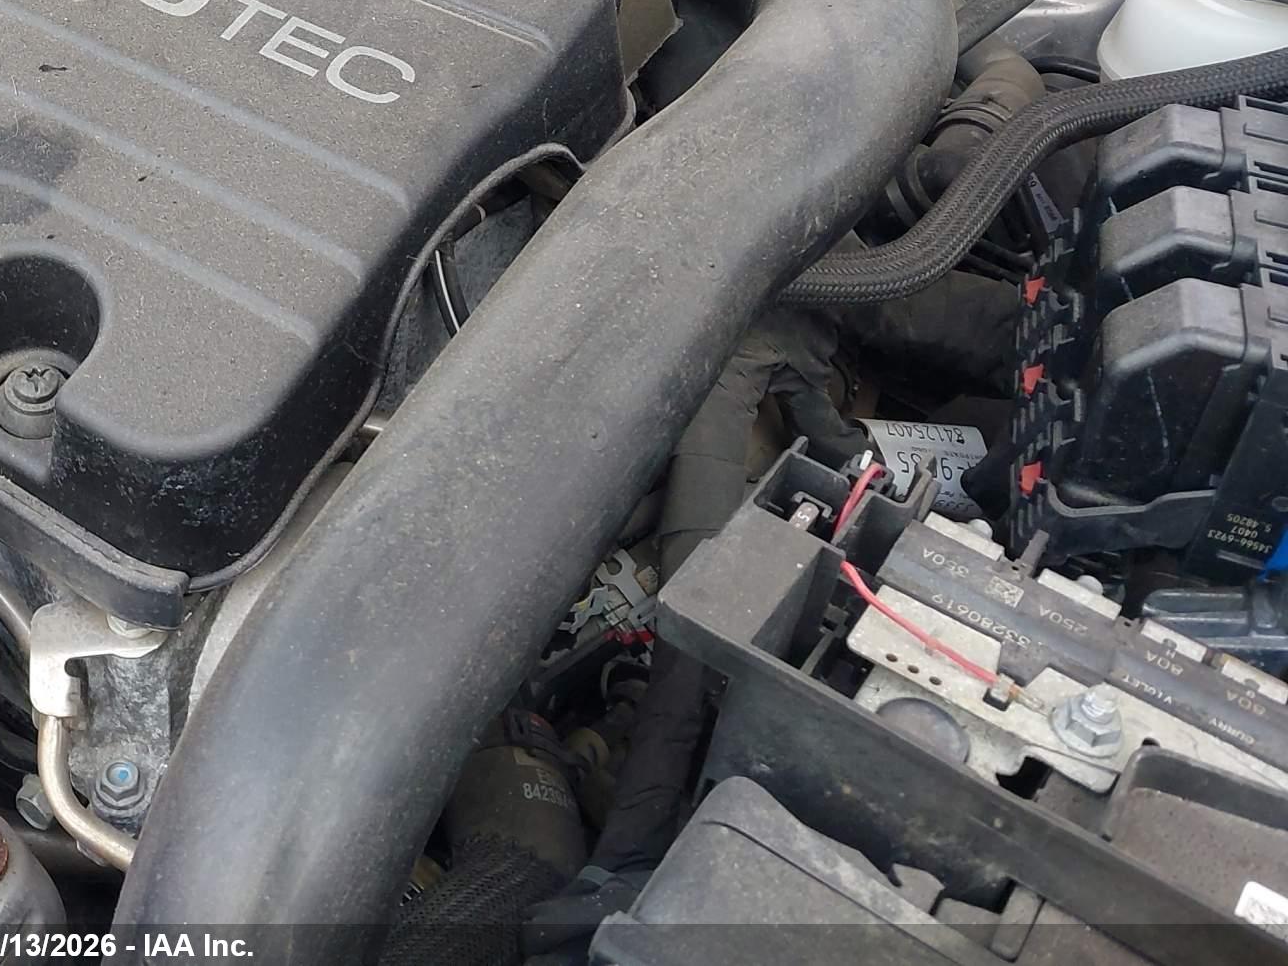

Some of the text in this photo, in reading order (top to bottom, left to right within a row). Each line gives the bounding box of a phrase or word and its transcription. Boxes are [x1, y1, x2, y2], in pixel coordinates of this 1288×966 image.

[887, 422, 965, 445] 84125407
[920, 545, 970, 578] 350A
[1039, 603, 1089, 637] 250A
